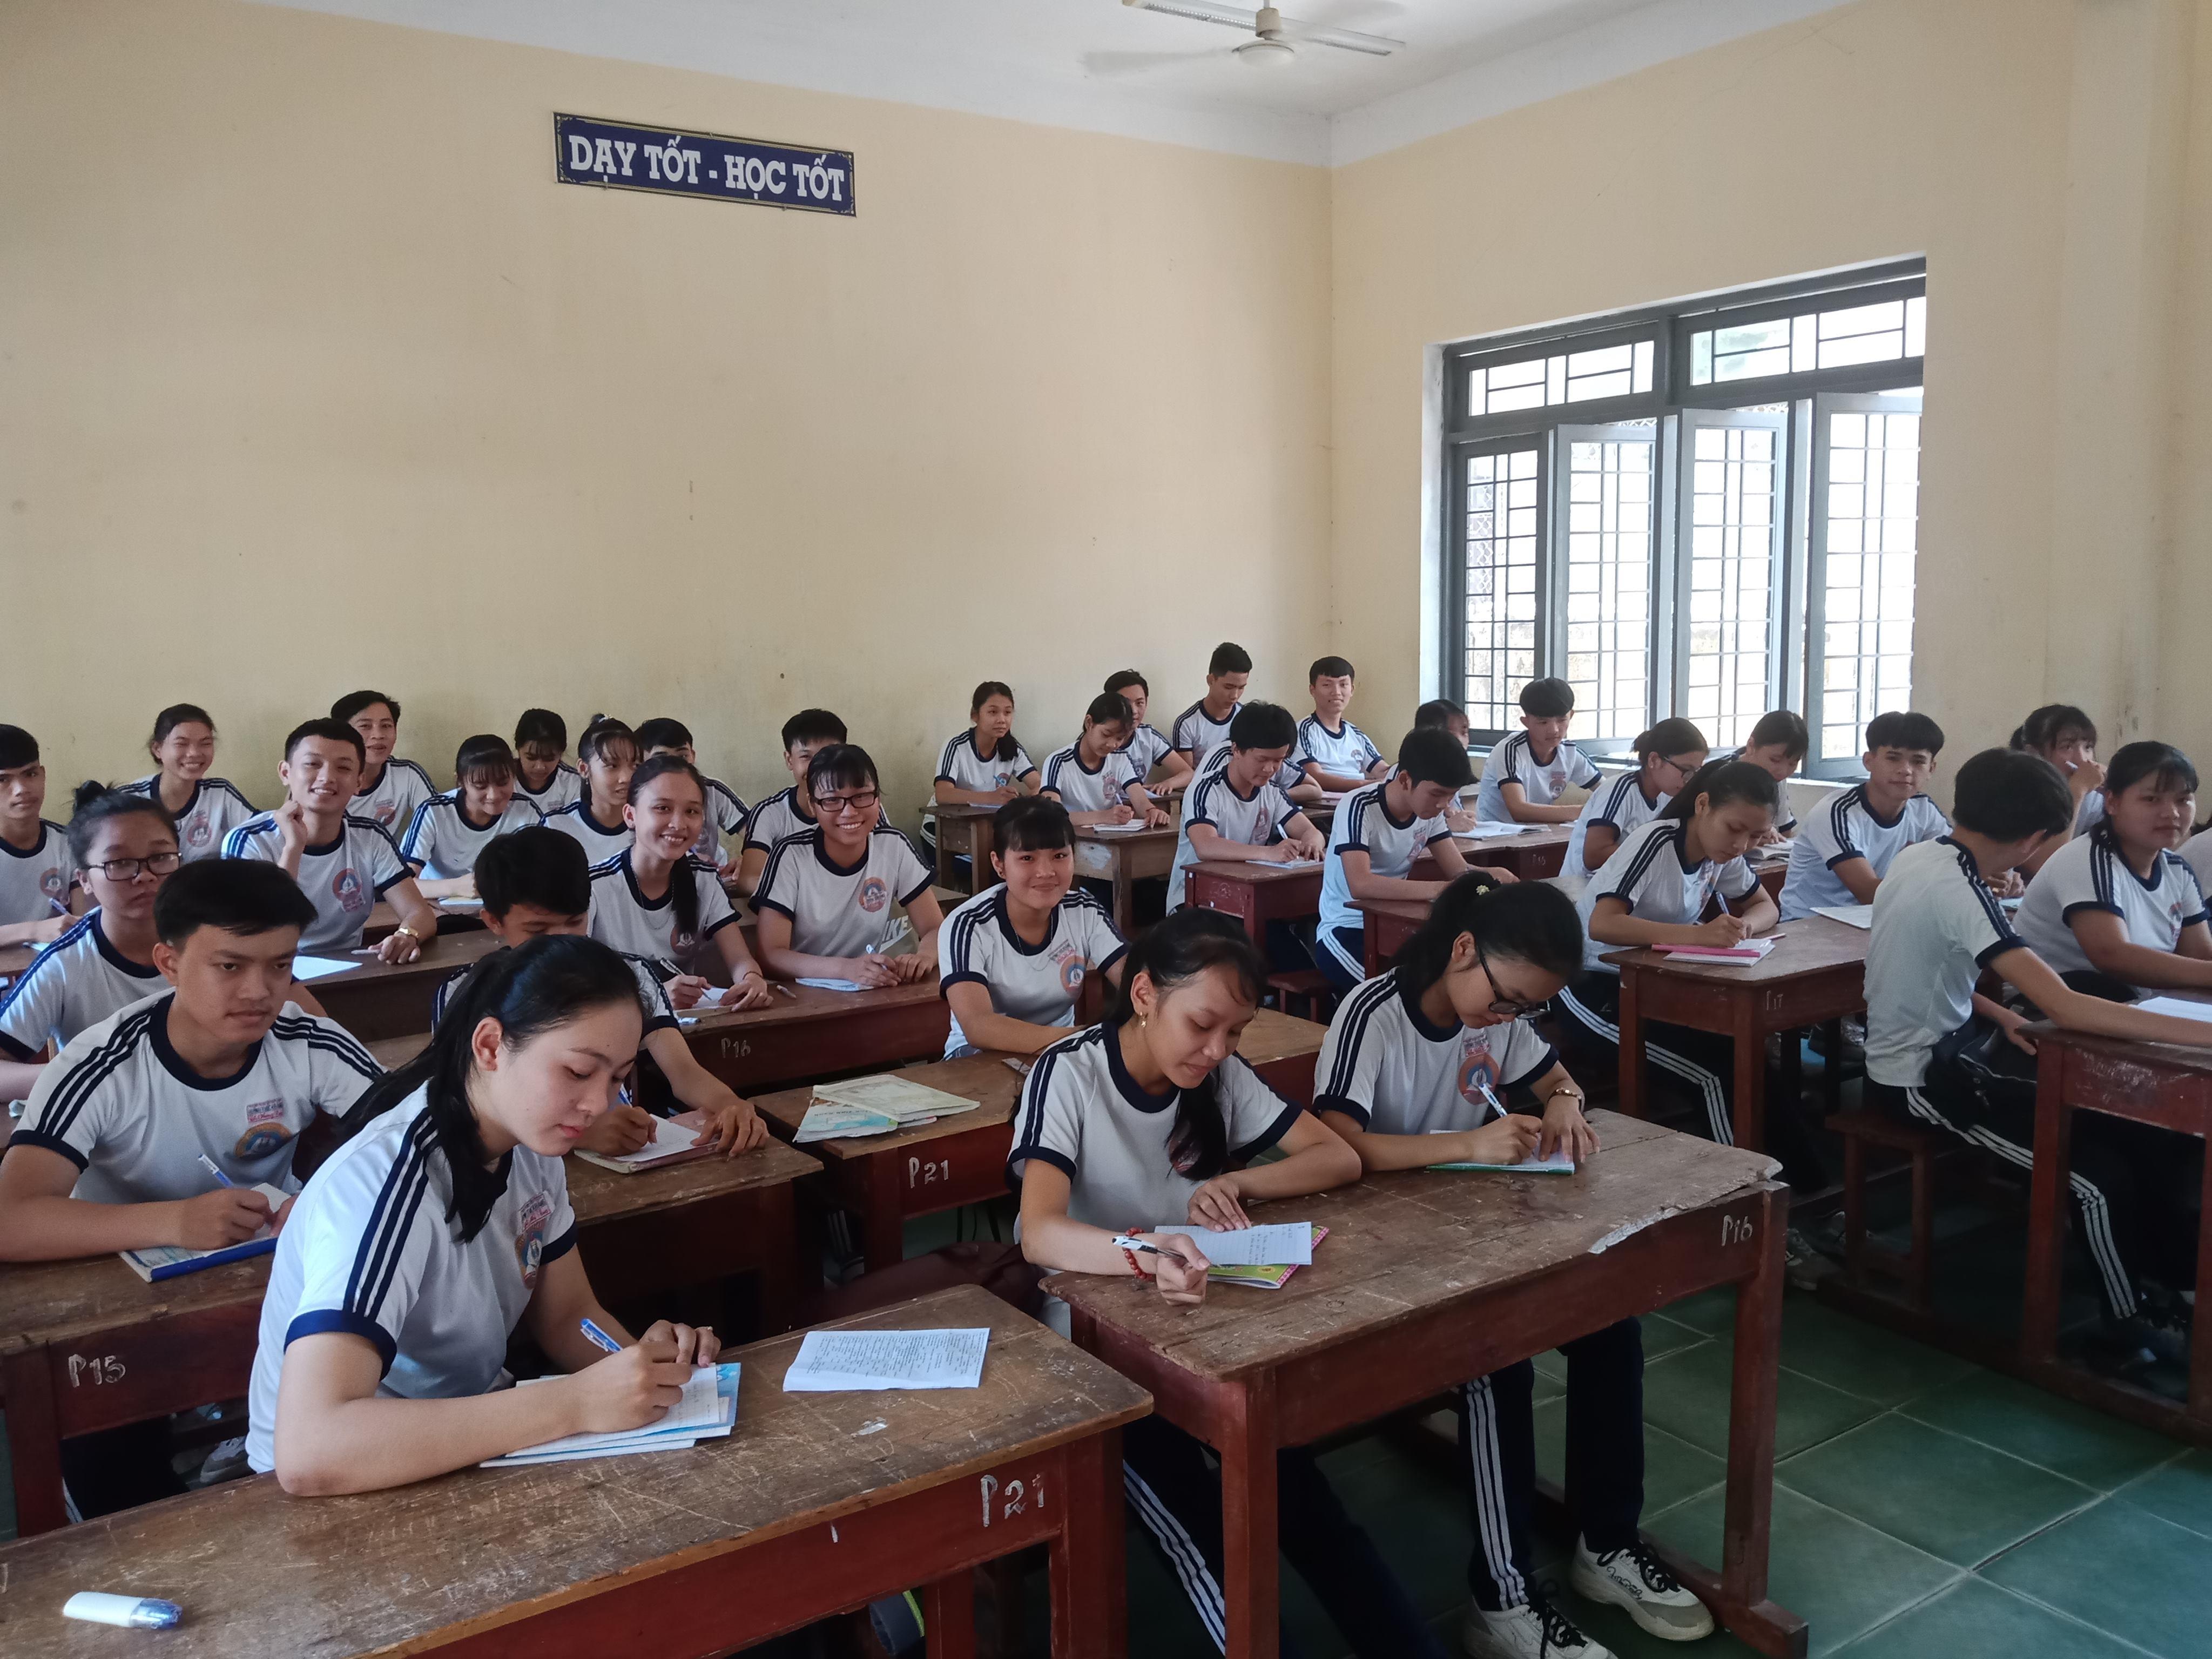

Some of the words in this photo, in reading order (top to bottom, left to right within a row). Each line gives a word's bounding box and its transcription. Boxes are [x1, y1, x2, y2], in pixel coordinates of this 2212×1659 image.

[569, 135, 637, 183] DẠY
[644, 135, 701, 184] TỐT
[724, 154, 787, 200] HỌC
[792, 154, 845, 201] TỐT
[909, 1157, 949, 1189] P21
[69, 1354, 126, 1388] P15
